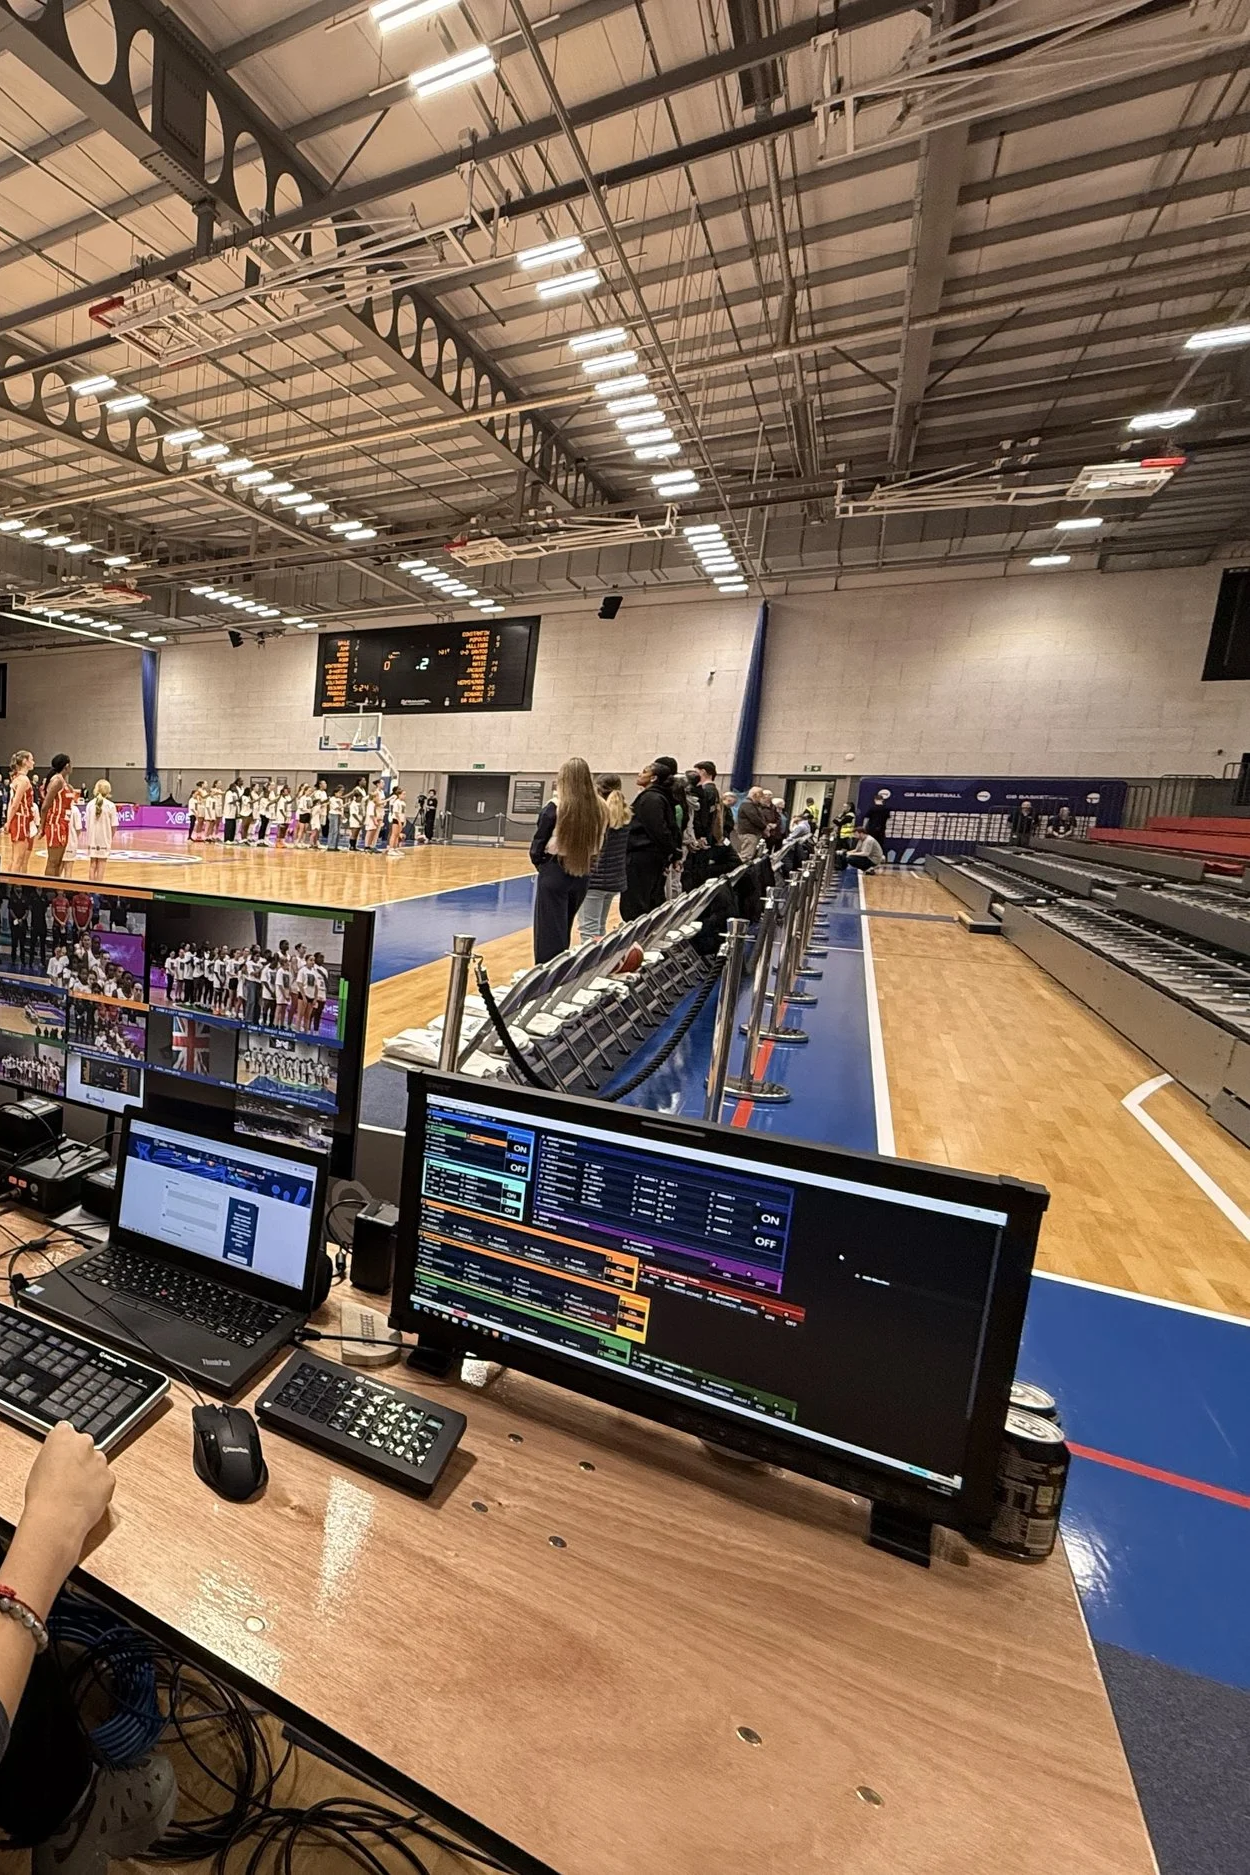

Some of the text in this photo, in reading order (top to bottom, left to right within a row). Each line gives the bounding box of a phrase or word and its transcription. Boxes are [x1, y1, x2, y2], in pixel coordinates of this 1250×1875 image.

[513, 1144, 527, 1154] ON
[510, 1163, 526, 1174] OFF
[506, 1192, 517, 1200] ON
[504, 1207, 516, 1215] OFF
[761, 1214, 780, 1226] ON
[755, 1236, 777, 1249] OFF
[201, 1358, 231, 1367] ThinkPad
